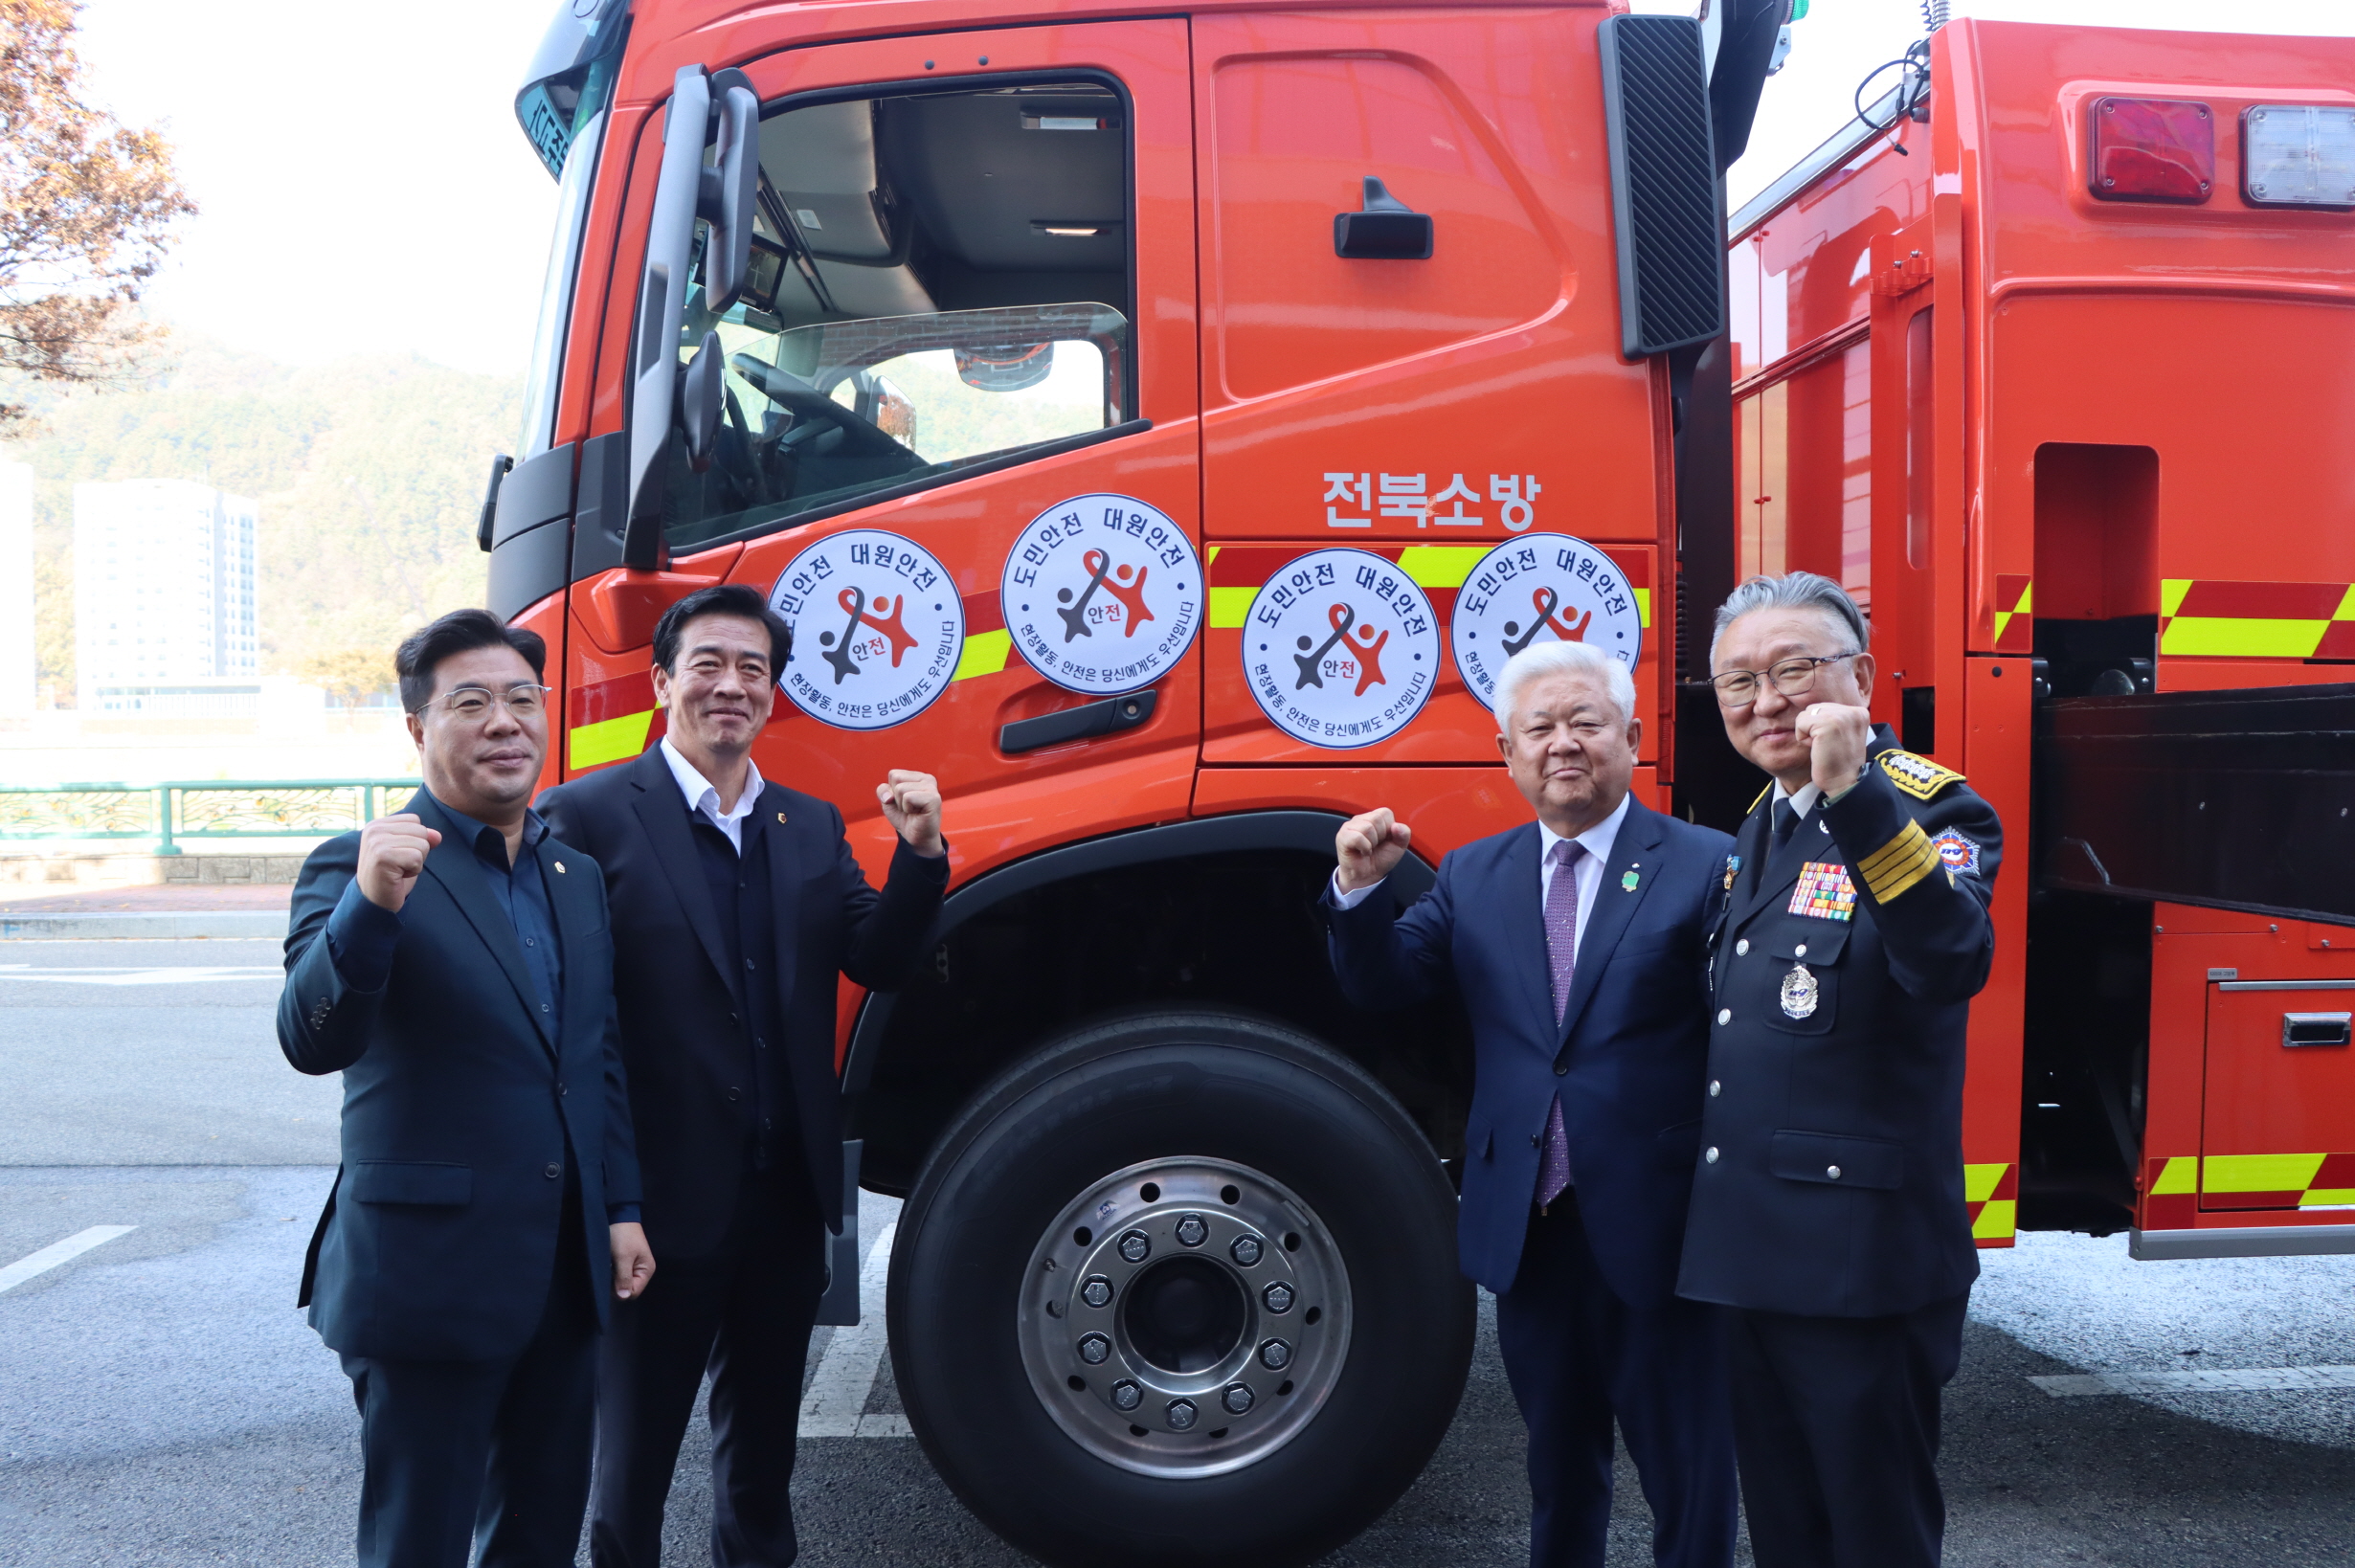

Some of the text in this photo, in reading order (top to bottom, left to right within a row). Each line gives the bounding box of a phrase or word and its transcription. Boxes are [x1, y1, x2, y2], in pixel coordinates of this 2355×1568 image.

[1324, 472, 1541, 532] 전북소방
[851, 544, 937, 593] 대원안전
[1014, 508, 1185, 588] 도민안전 대원안전
[1088, 604, 1121, 624] 안전
[1258, 563, 1426, 637] 도민안전 대원안전
[1465, 549, 1627, 616] 도민안전 대원안전
[791, 621, 954, 718] 현장활동, 안전은 당신에게도 우선입니다
[852, 638, 886, 661] 안전
[1021, 601, 1194, 683] 현장활동, 안전은 당신에게도 우선입니다
[1323, 661, 1355, 678] 안전
[1255, 663, 1426, 736] 현장활동, 안전은 당신에게도 우선입니다
